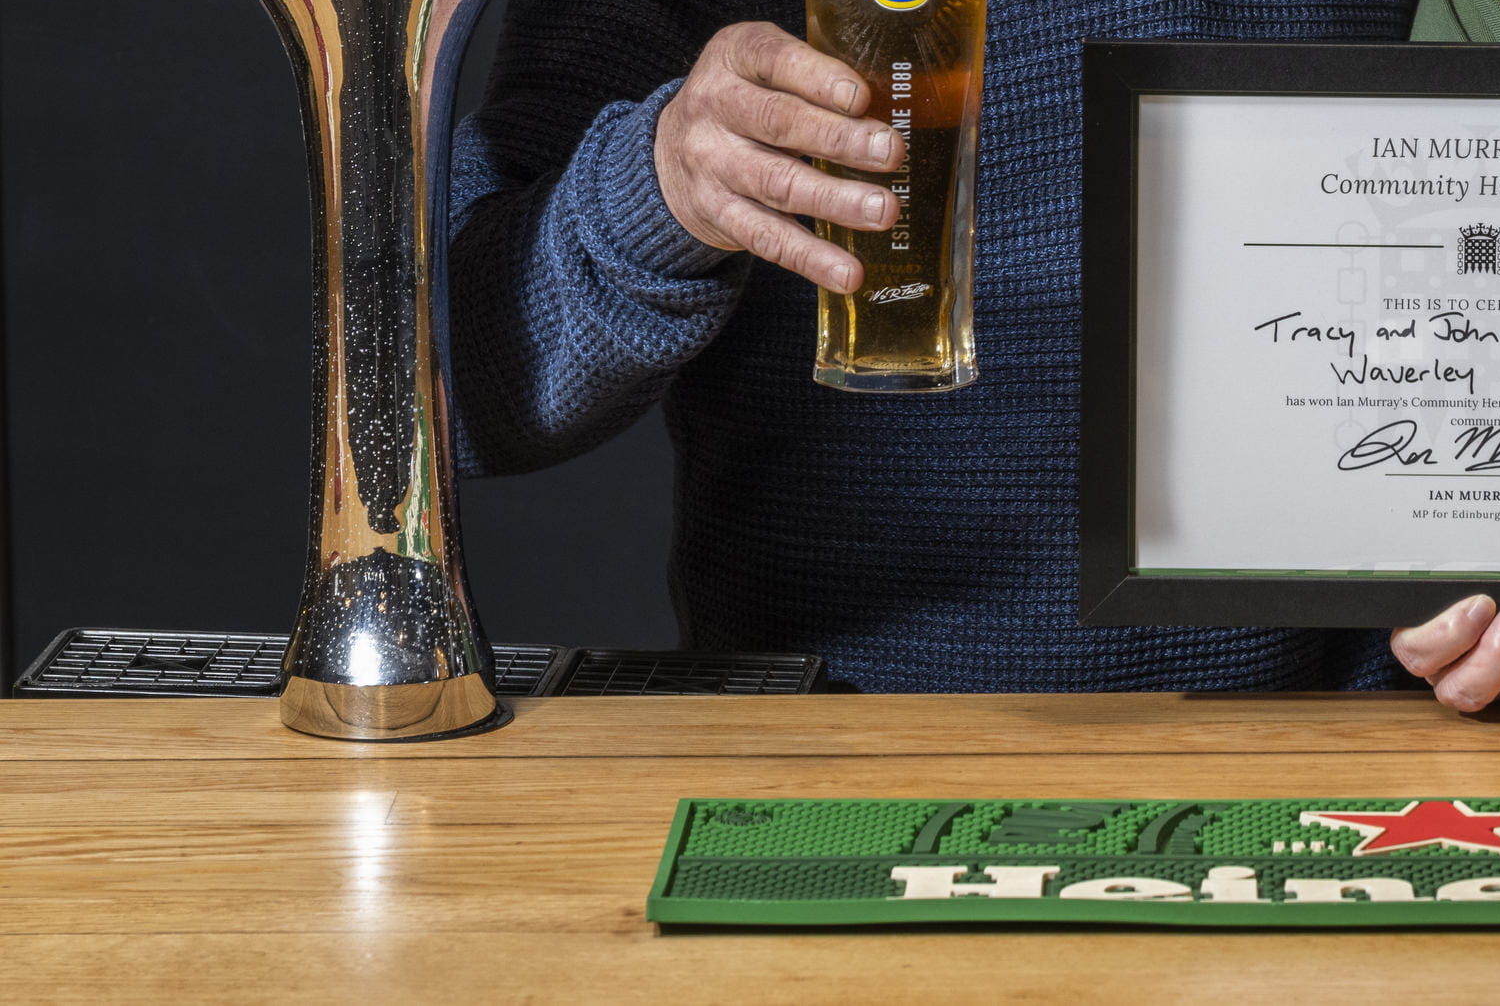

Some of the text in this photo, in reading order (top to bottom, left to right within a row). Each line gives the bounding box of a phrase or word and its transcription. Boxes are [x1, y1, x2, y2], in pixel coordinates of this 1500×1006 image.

[891, 61, 912, 101] 1888
[1371, 137, 1420, 159] IAN
[1320, 172, 1469, 202] Community
[1383, 297, 1421, 311] THIS
[1426, 298, 1441, 311] IS
[1447, 298, 1469, 311] TO
[1254, 311, 1356, 357] Tracy
[1376, 318, 1416, 340] and
[1428, 311, 1500, 344] John
[1330, 355, 1475, 395] Waverley
[1285, 395, 1306, 407] has
[1309, 398, 1333, 407] won
[1336, 396, 1355, 407] Ian
[1357, 396, 1408, 411] Murray's
[1411, 396, 1479, 412] Community
[1429, 490, 1455, 501] IAN
[1412, 509, 1430, 520] MP
[1432, 509, 1450, 520] for
